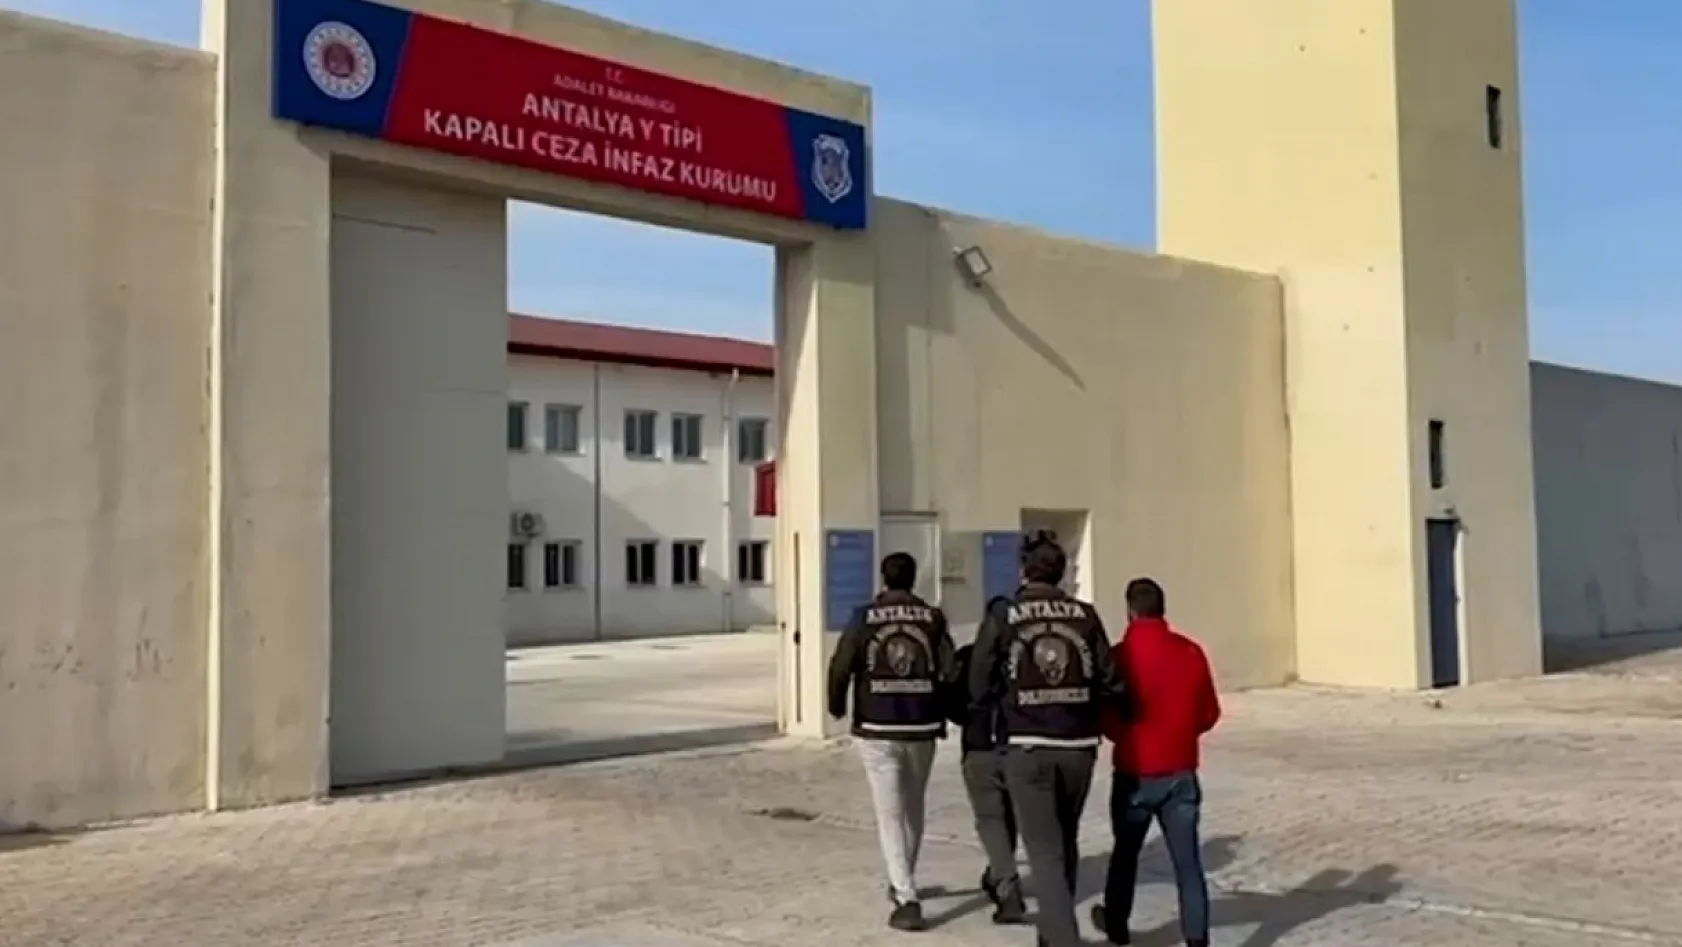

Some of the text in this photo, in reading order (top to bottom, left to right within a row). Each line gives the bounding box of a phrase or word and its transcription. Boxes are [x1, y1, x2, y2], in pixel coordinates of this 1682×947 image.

[522, 92, 703, 153] ANTALYA Y TİPİ
[423, 108, 777, 203] KAPALI CEZA İNFAZ KURUMU
[866, 604, 933, 624] ANTALYA
[1007, 599, 1087, 624] ANTALYA
